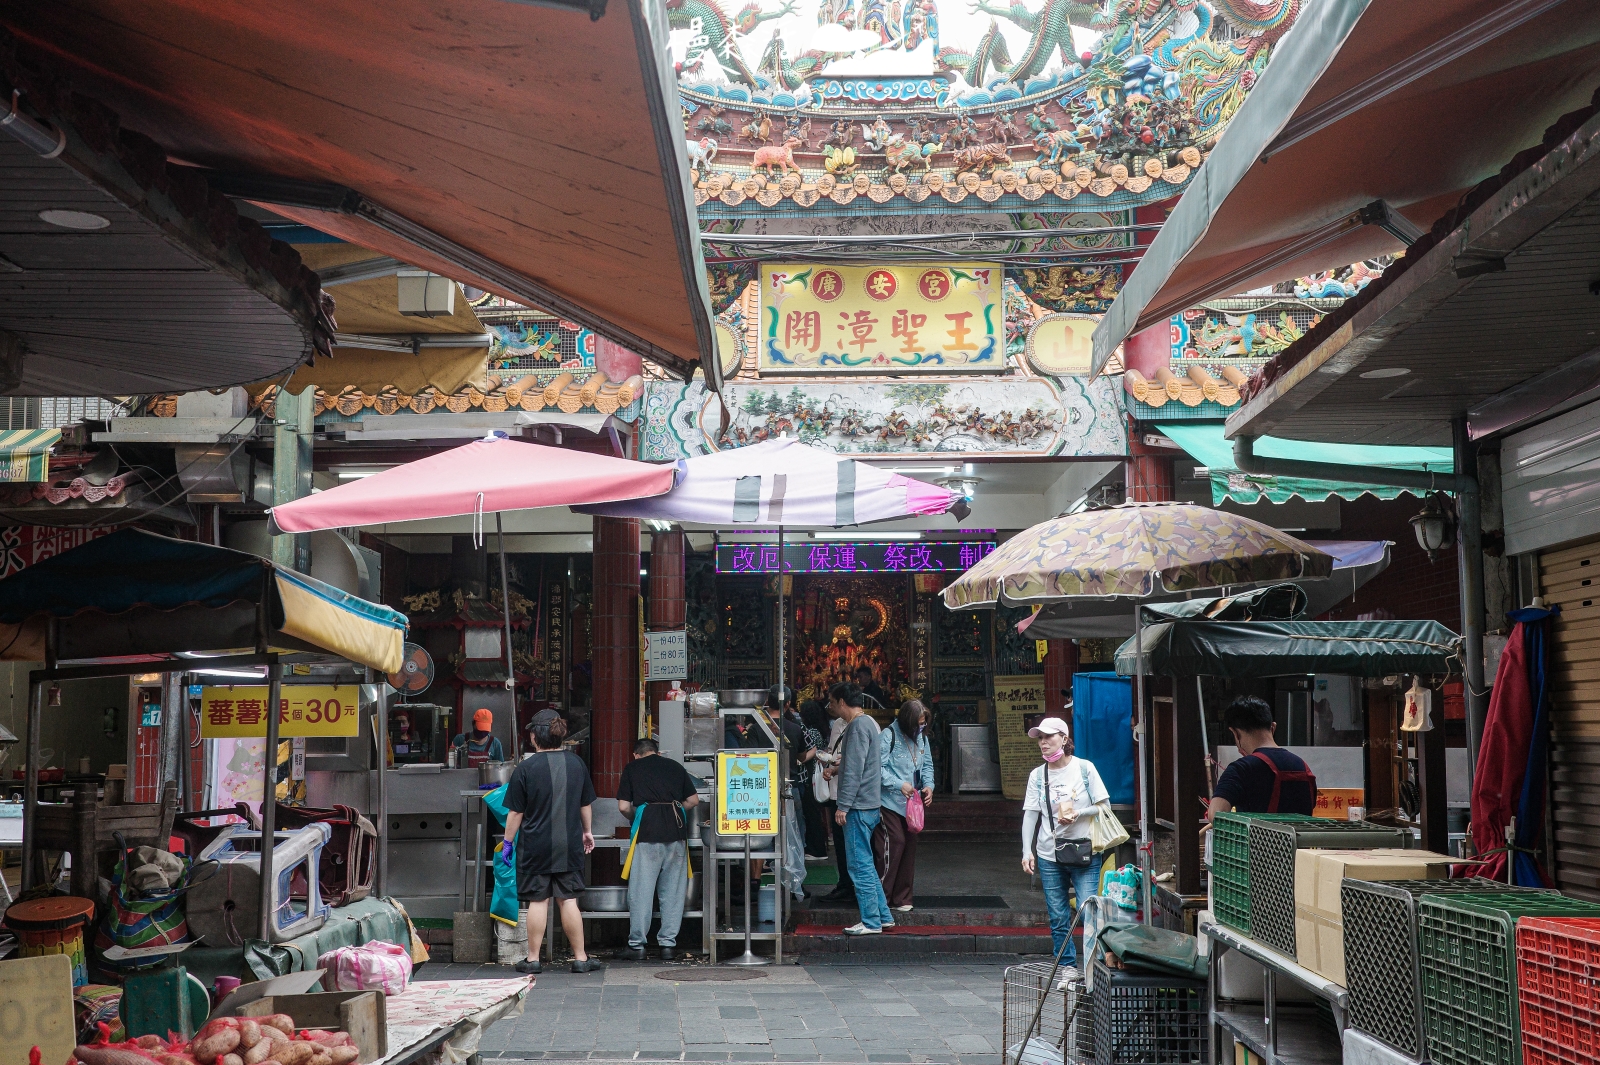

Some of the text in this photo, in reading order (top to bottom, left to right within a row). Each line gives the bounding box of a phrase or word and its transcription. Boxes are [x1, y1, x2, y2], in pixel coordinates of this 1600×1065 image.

[815, 271, 946, 297] 廣安宮
[785, 308, 980, 354] 開漳聖王
[653, 635, 684, 645] 一份40元
[653, 650, 684, 660] 二份80元
[653, 665, 685, 675] 三份120元
[729, 777, 767, 790] 生鴨腳
[1317, 796, 1359, 809] 補貨中
